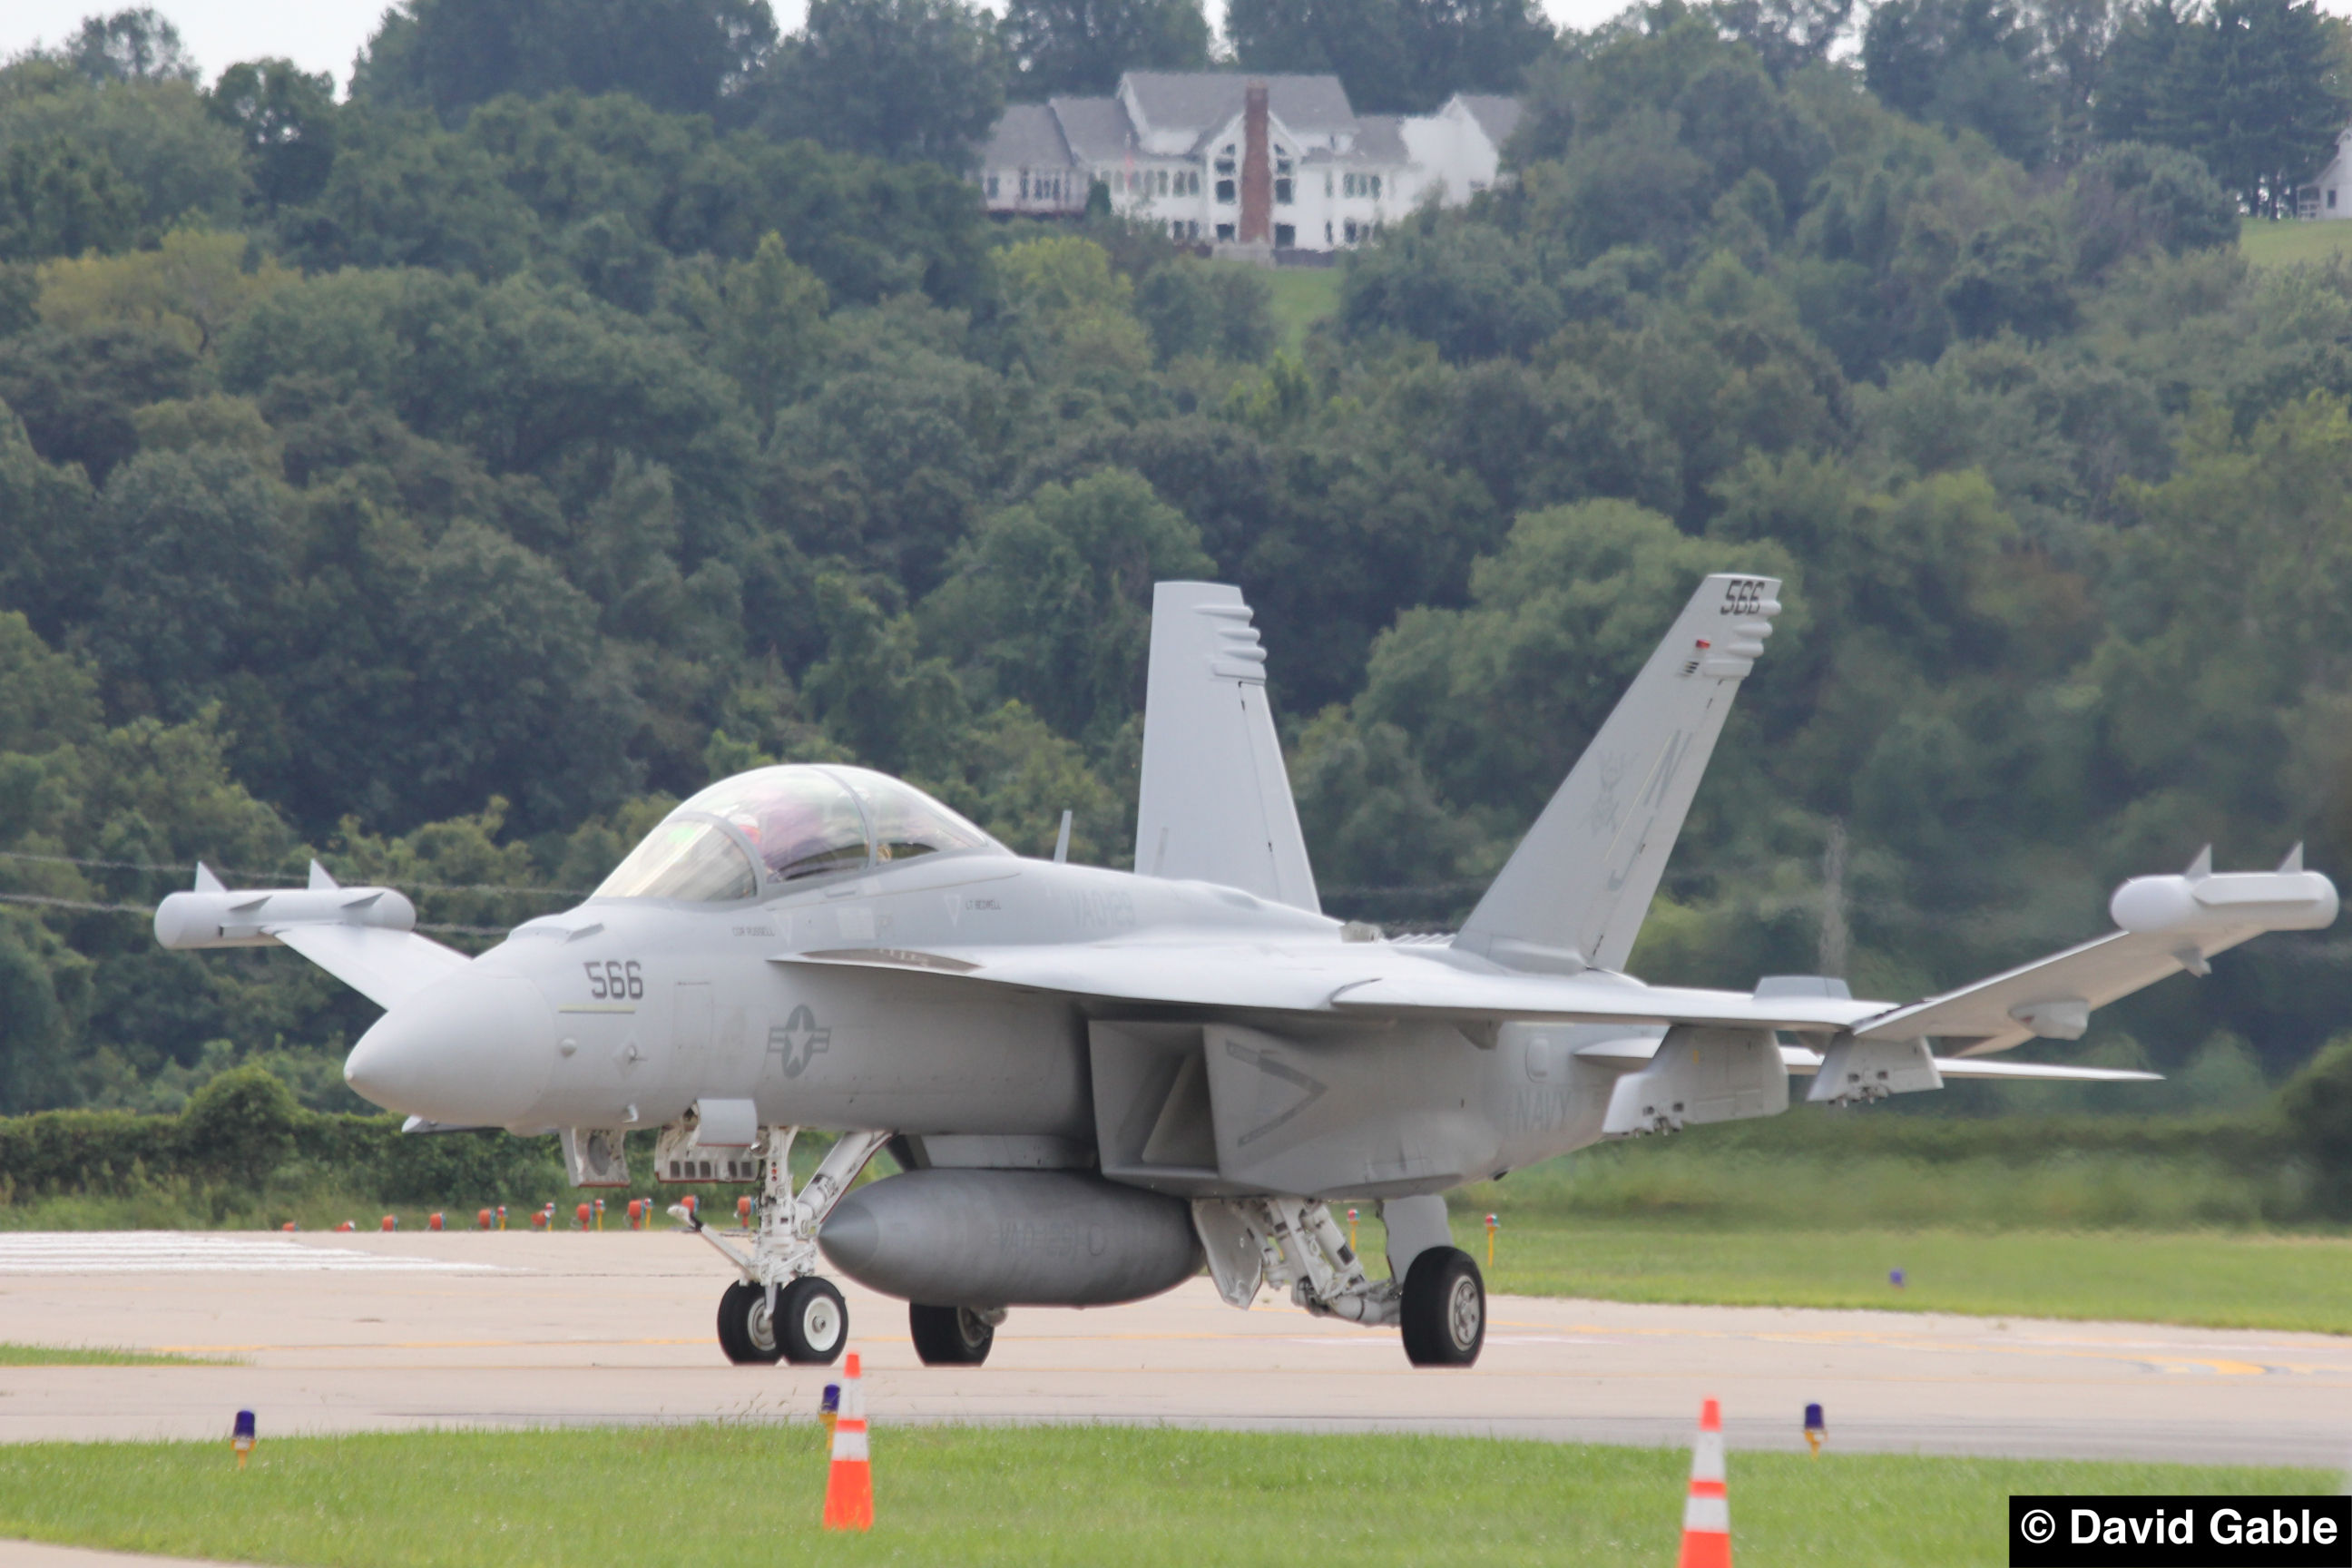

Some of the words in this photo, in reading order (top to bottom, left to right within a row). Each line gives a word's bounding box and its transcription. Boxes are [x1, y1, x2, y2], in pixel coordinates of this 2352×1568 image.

[1720, 579, 1765, 616] 566
[583, 959, 644, 1000] 566
[1515, 1090, 1573, 1133] NAVY
